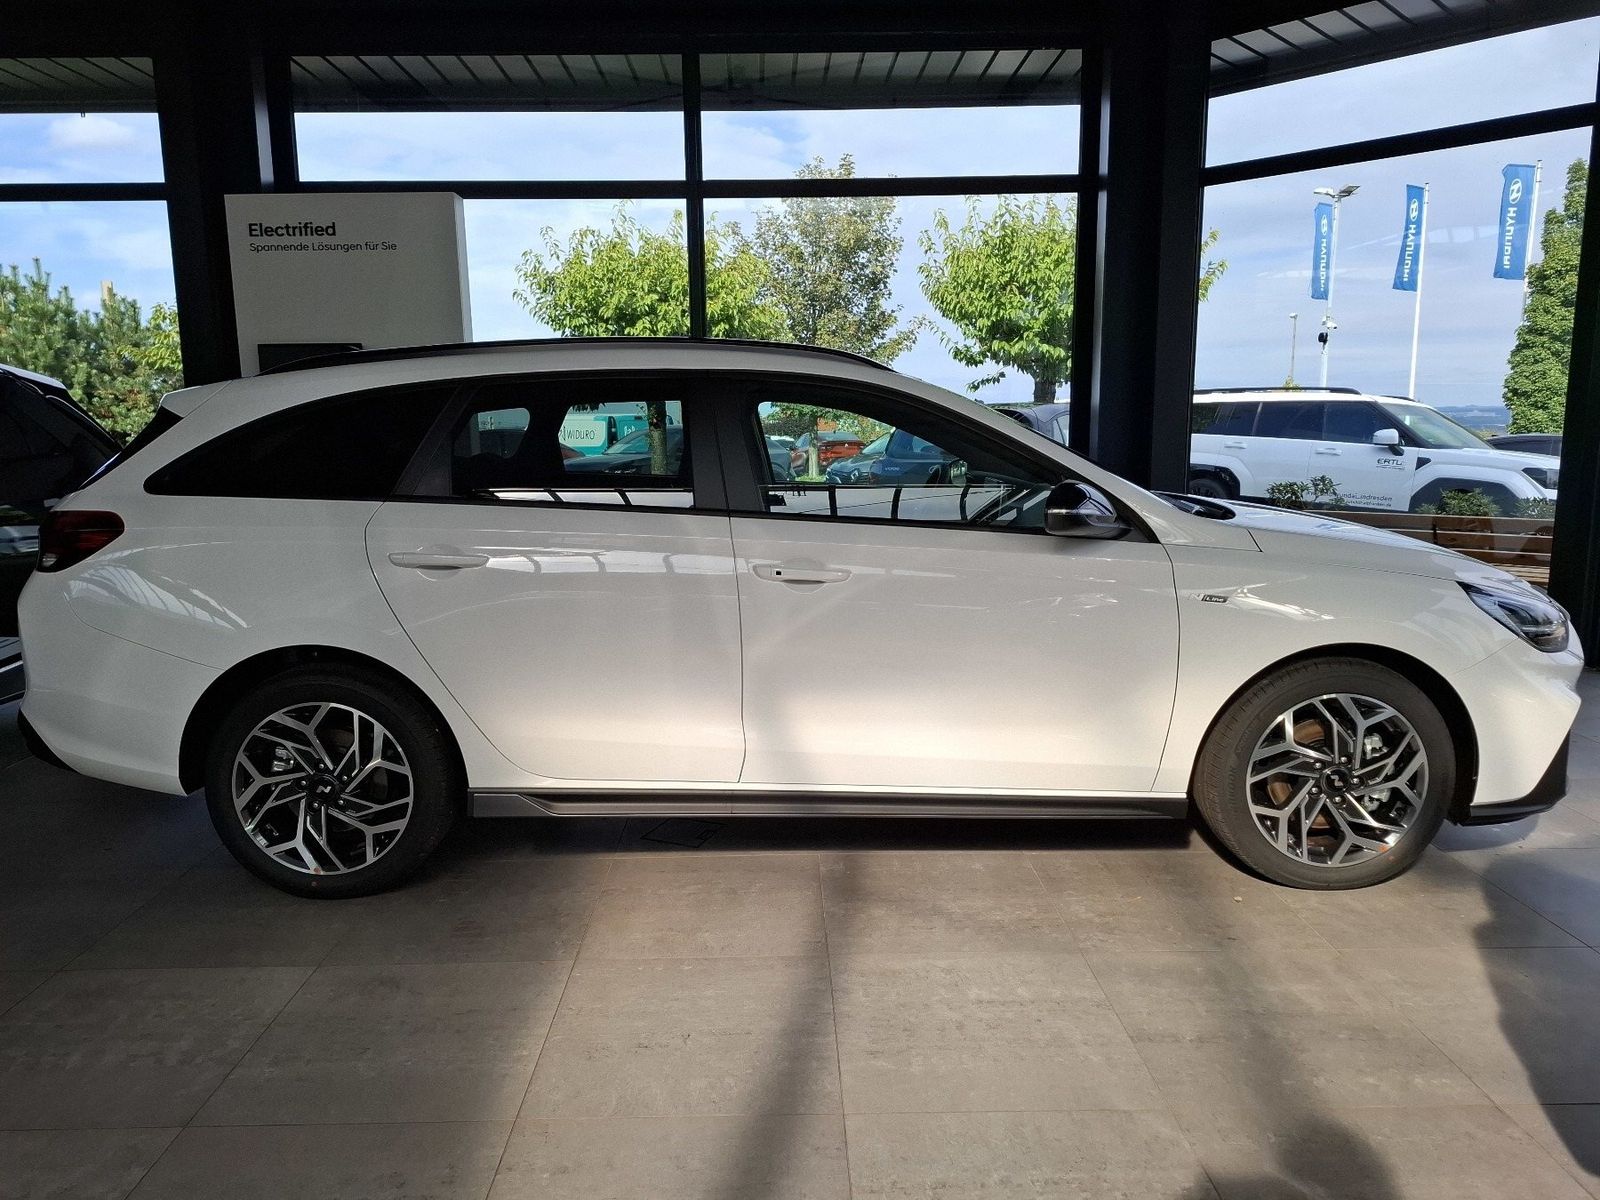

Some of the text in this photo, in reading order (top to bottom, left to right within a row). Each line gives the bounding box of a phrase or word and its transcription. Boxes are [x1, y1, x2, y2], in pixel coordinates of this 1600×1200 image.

[248, 222, 337, 237] Electrified
[249, 240, 397, 253] Spannende Lösungen für Sie
[566, 429, 595, 440] WIDURO
[1377, 458, 1403, 466] ERTL
